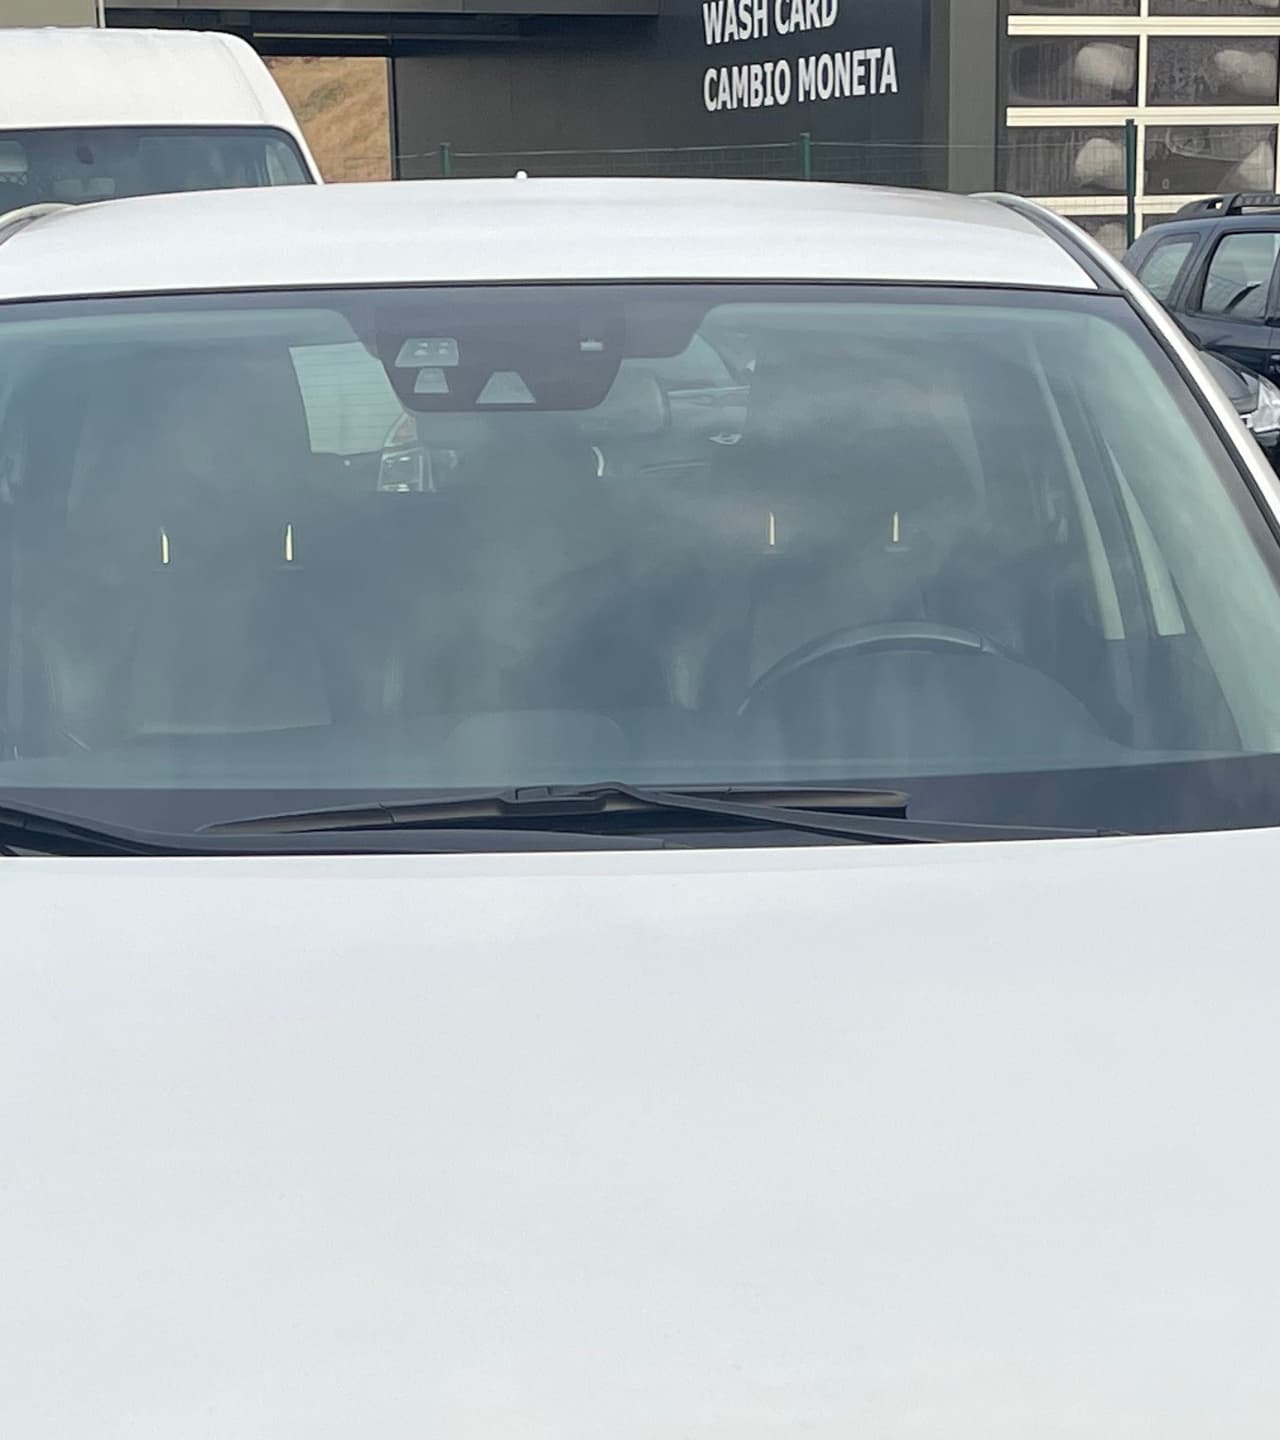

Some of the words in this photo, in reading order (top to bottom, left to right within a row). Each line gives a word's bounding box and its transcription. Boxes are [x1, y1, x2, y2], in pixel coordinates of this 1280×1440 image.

[703, 0, 767, 44] WASH
[775, 0, 838, 34] CARD
[704, 60, 791, 111] CAMBIO
[798, 47, 898, 102] MONETA
